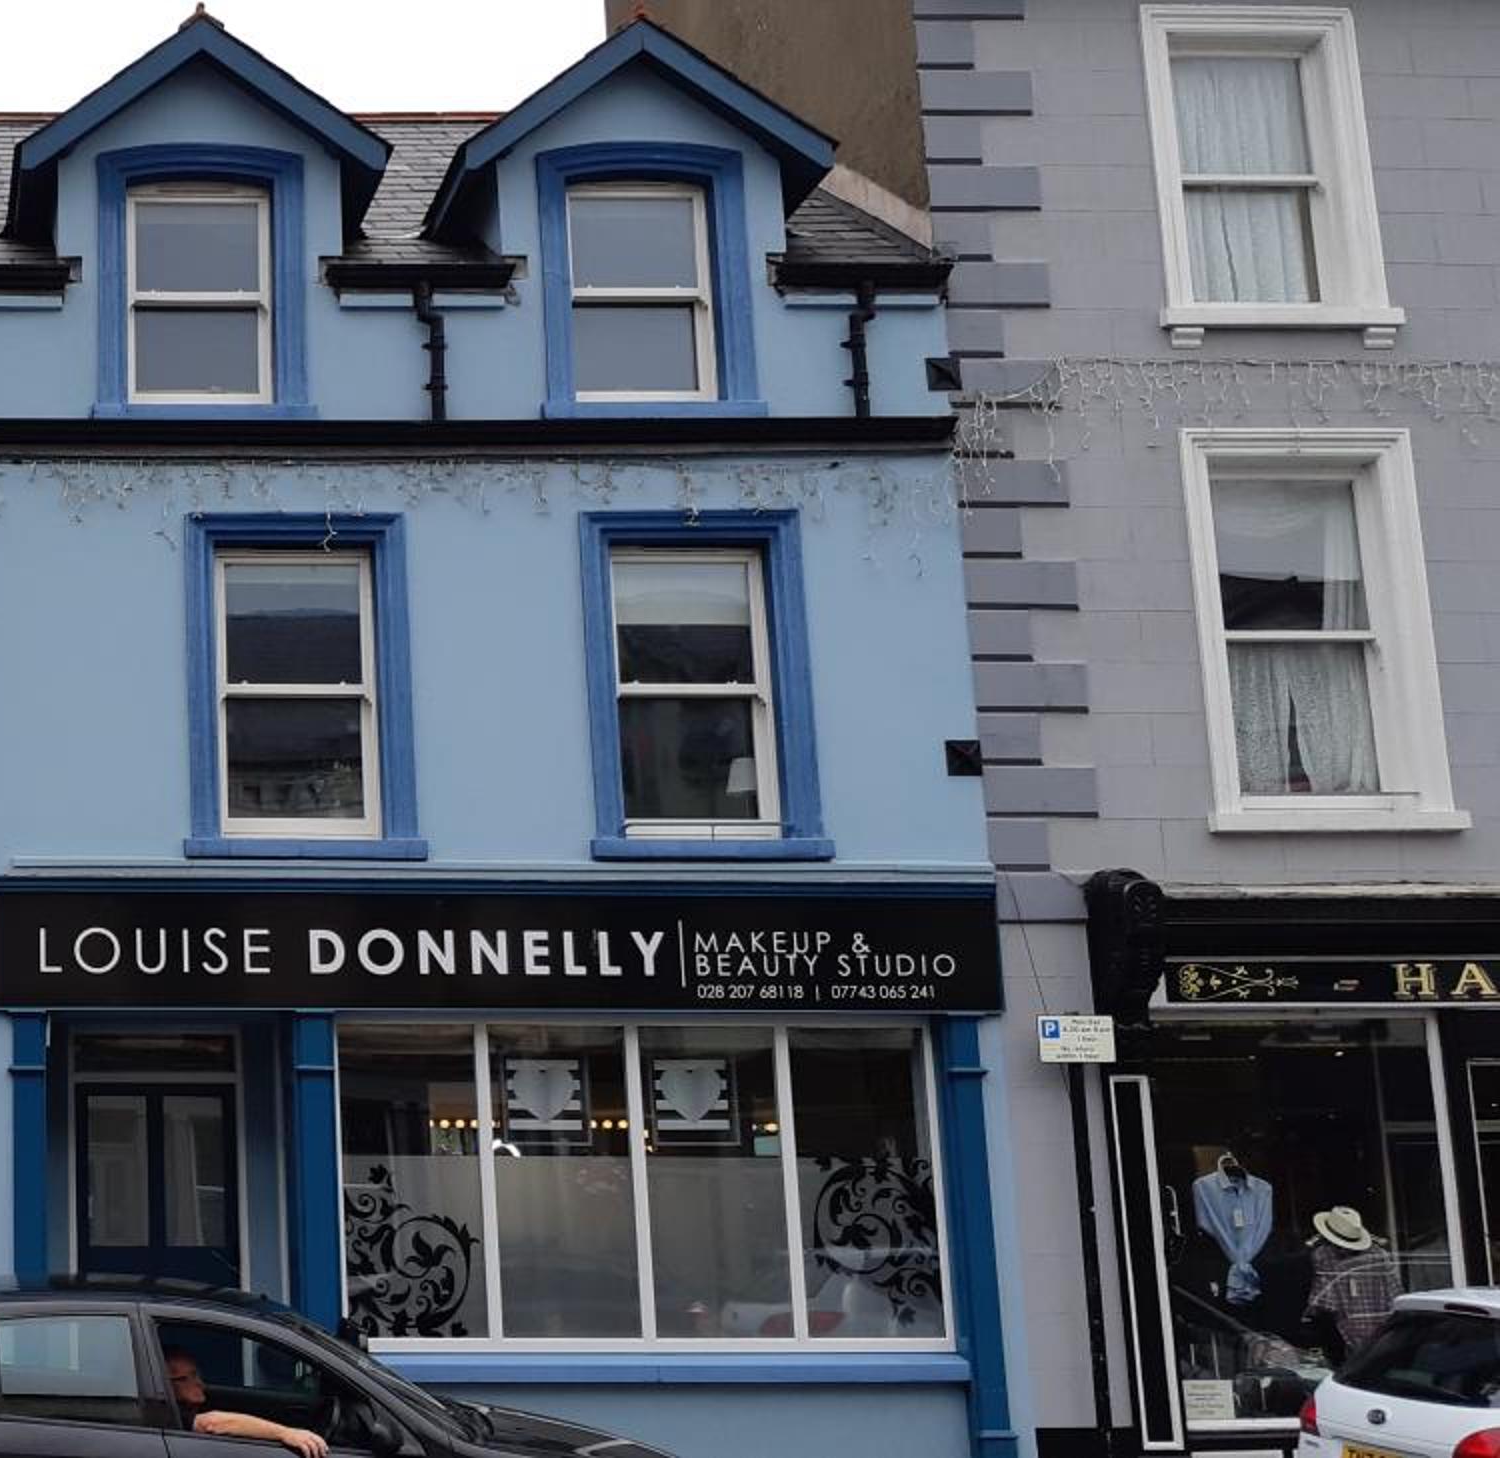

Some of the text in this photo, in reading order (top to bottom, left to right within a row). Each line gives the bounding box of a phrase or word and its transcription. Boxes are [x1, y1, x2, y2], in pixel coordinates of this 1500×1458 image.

[39, 926, 665, 977] LOUISE DONNELLY
[694, 931, 871, 954] MAKEUP &
[695, 953, 956, 977] BEAUTY STUDIO
[697, 984, 725, 999] 028
[728, 984, 755, 999] 207
[759, 984, 804, 999] 68118
[831, 984, 877, 999] 07743
[879, 984, 907, 999] 065
[910, 984, 935, 999] 241
[1391, 962, 1500, 999] HA
[1045, 1022, 1056, 1037] P
